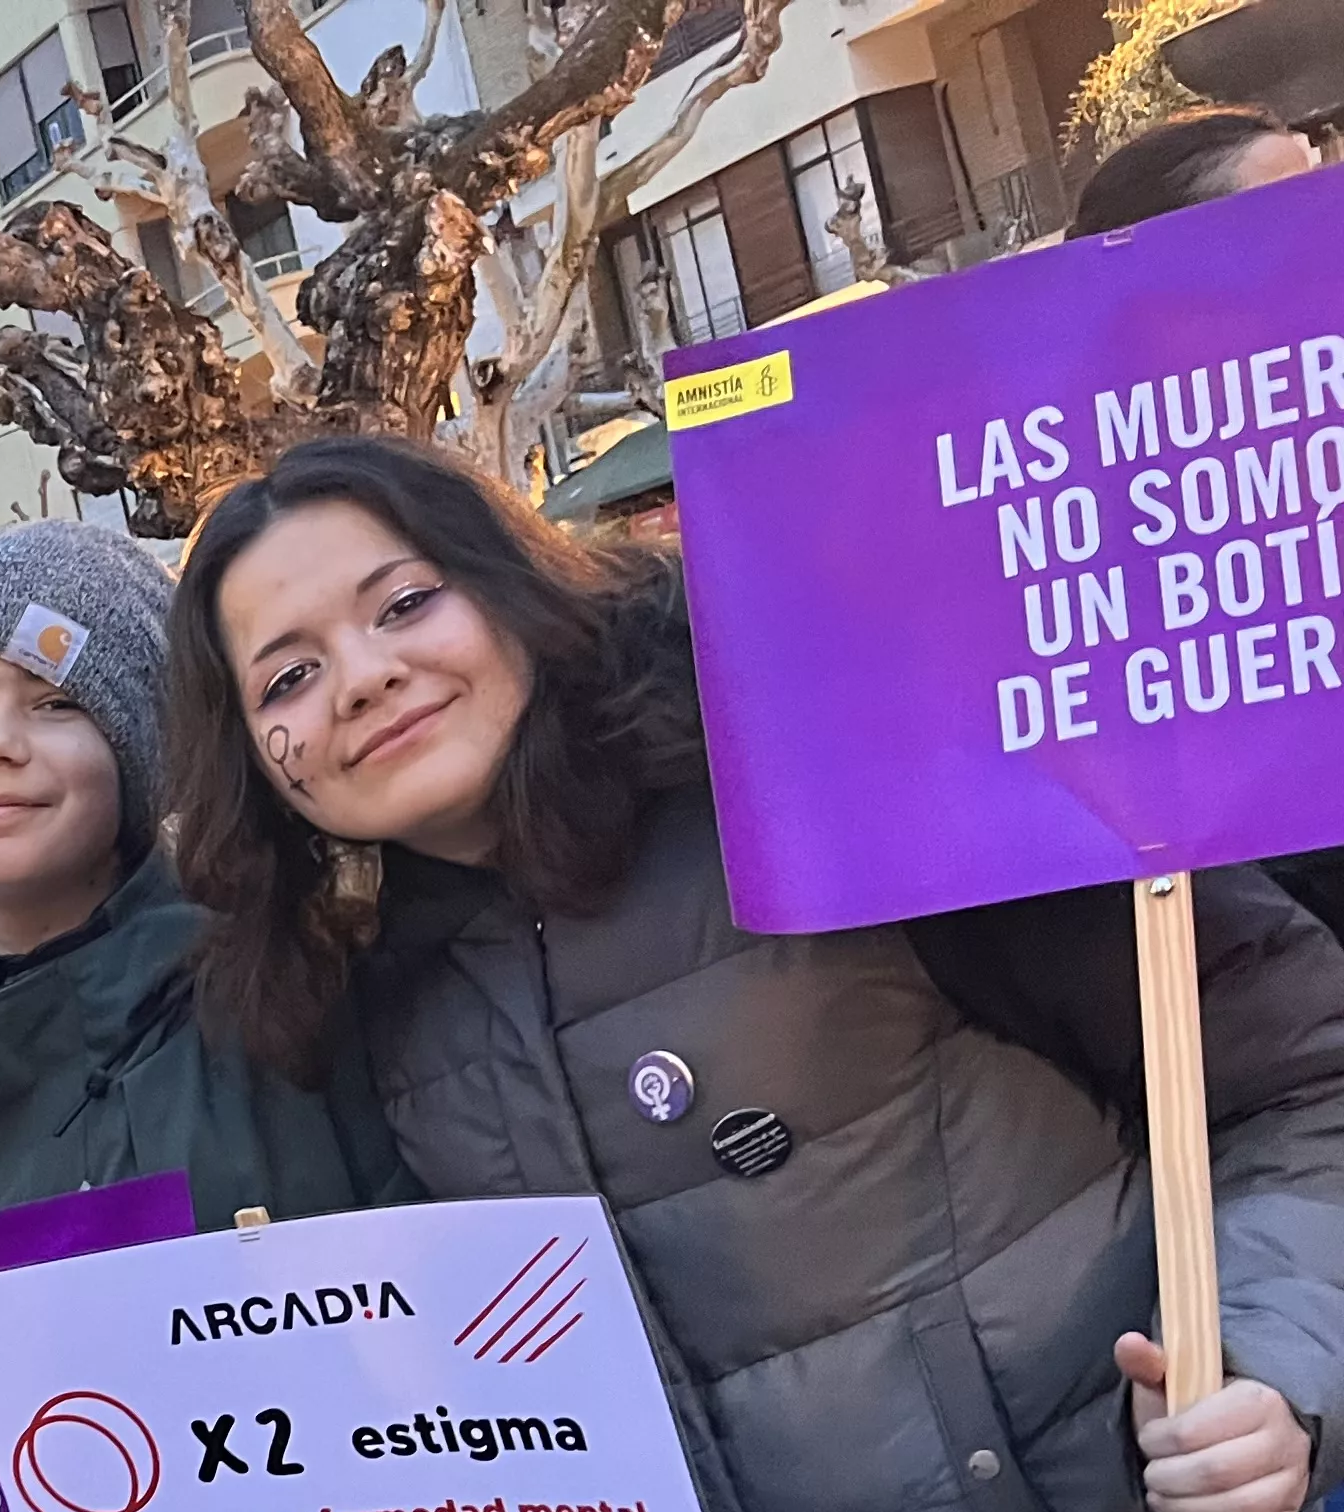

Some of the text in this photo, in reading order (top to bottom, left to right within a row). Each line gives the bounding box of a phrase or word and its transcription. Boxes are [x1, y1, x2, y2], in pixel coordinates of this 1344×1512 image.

[677, 375, 743, 406] AMNISTÍA
[936, 333, 1344, 507] LAS MUJER
[997, 485, 1102, 579] NO
[1023, 500, 1342, 658] UN BOTÍ
[996, 614, 1343, 753] DE GUER
[351, 1405, 589, 1463] estigma
